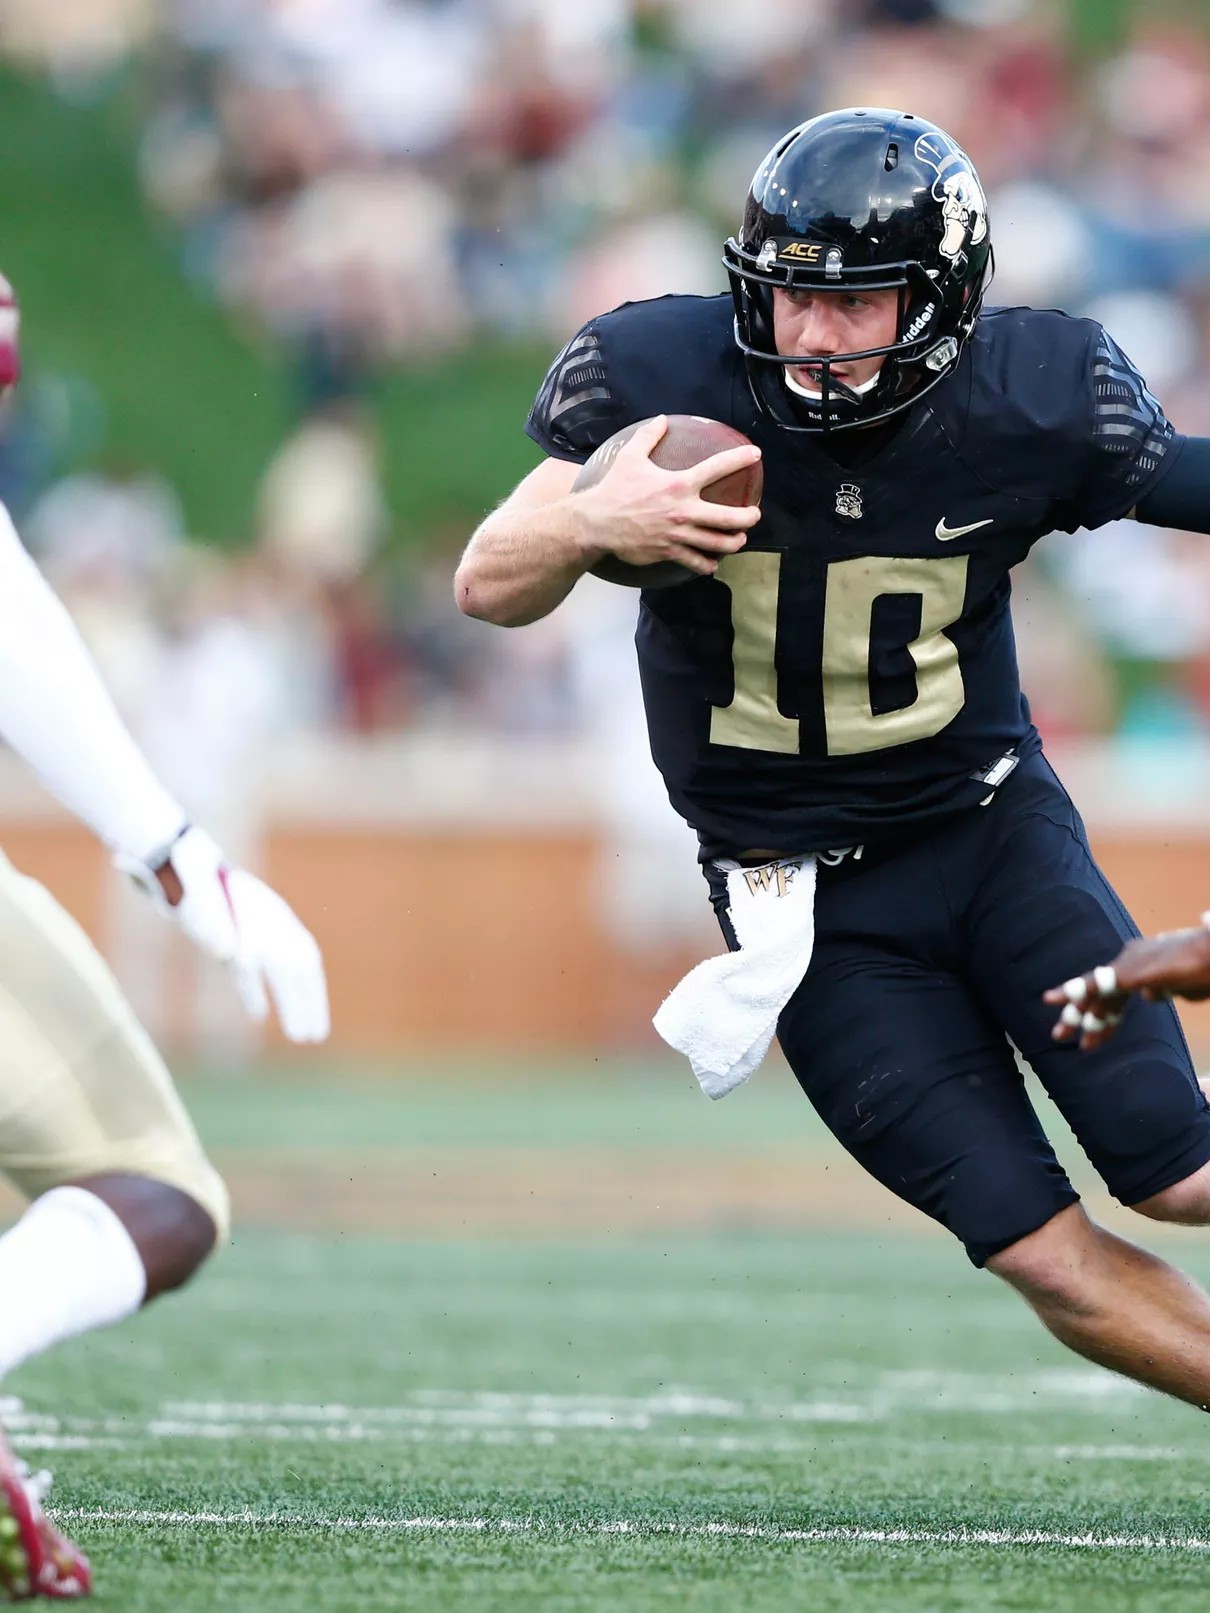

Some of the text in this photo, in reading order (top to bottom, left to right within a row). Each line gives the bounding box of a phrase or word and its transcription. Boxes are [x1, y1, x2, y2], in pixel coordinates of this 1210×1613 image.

[781, 242, 822, 258] ACC
[709, 550, 970, 756] 10
[742, 861, 804, 898] WF
